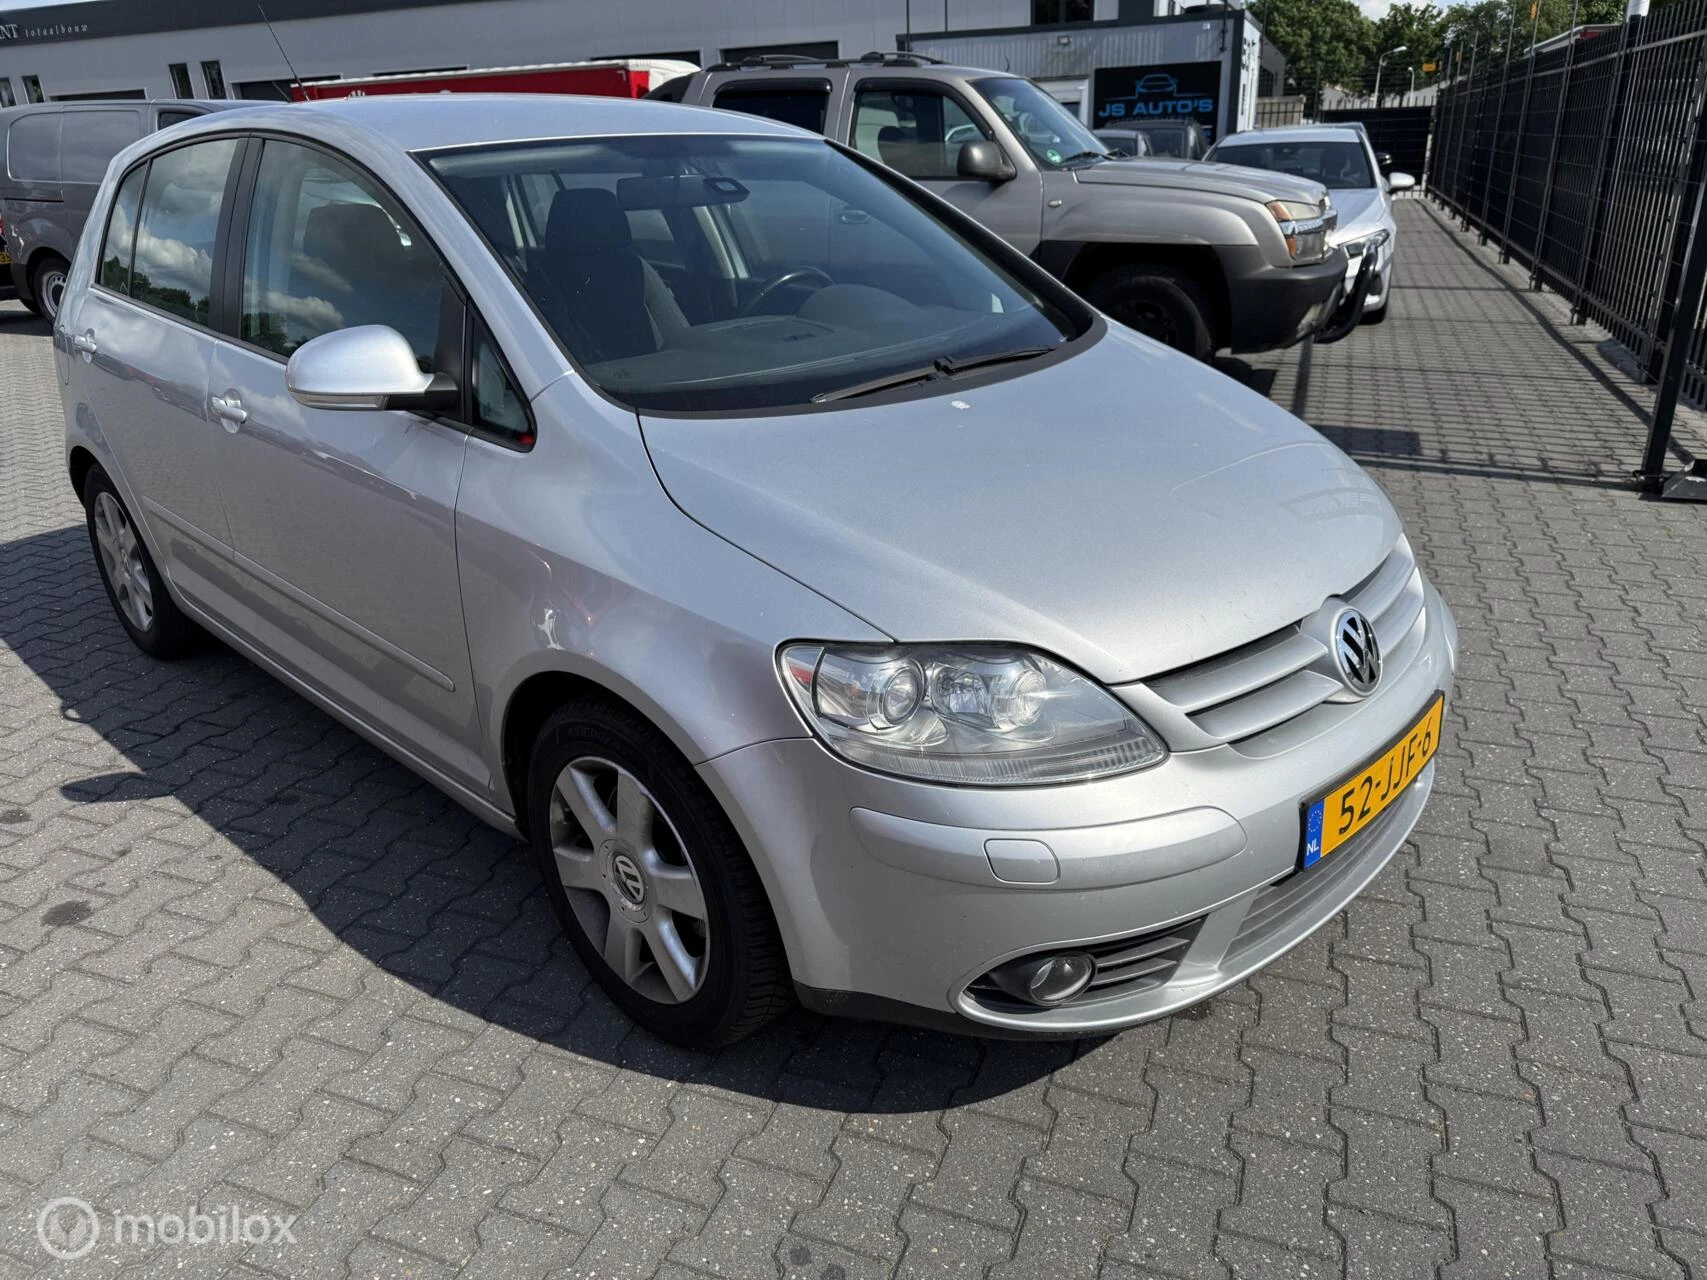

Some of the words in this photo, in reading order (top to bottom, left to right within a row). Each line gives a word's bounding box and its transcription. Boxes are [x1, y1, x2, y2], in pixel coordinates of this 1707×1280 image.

[0, 24, 19, 40] NT
[25, 24, 88, 38] totaalbouw
[1099, 103, 1126, 117] JS
[1132, 99, 1214, 116] AUTO'S
[1338, 716, 1433, 836] 52-JJF-6
[1306, 838, 1319, 857] NL
